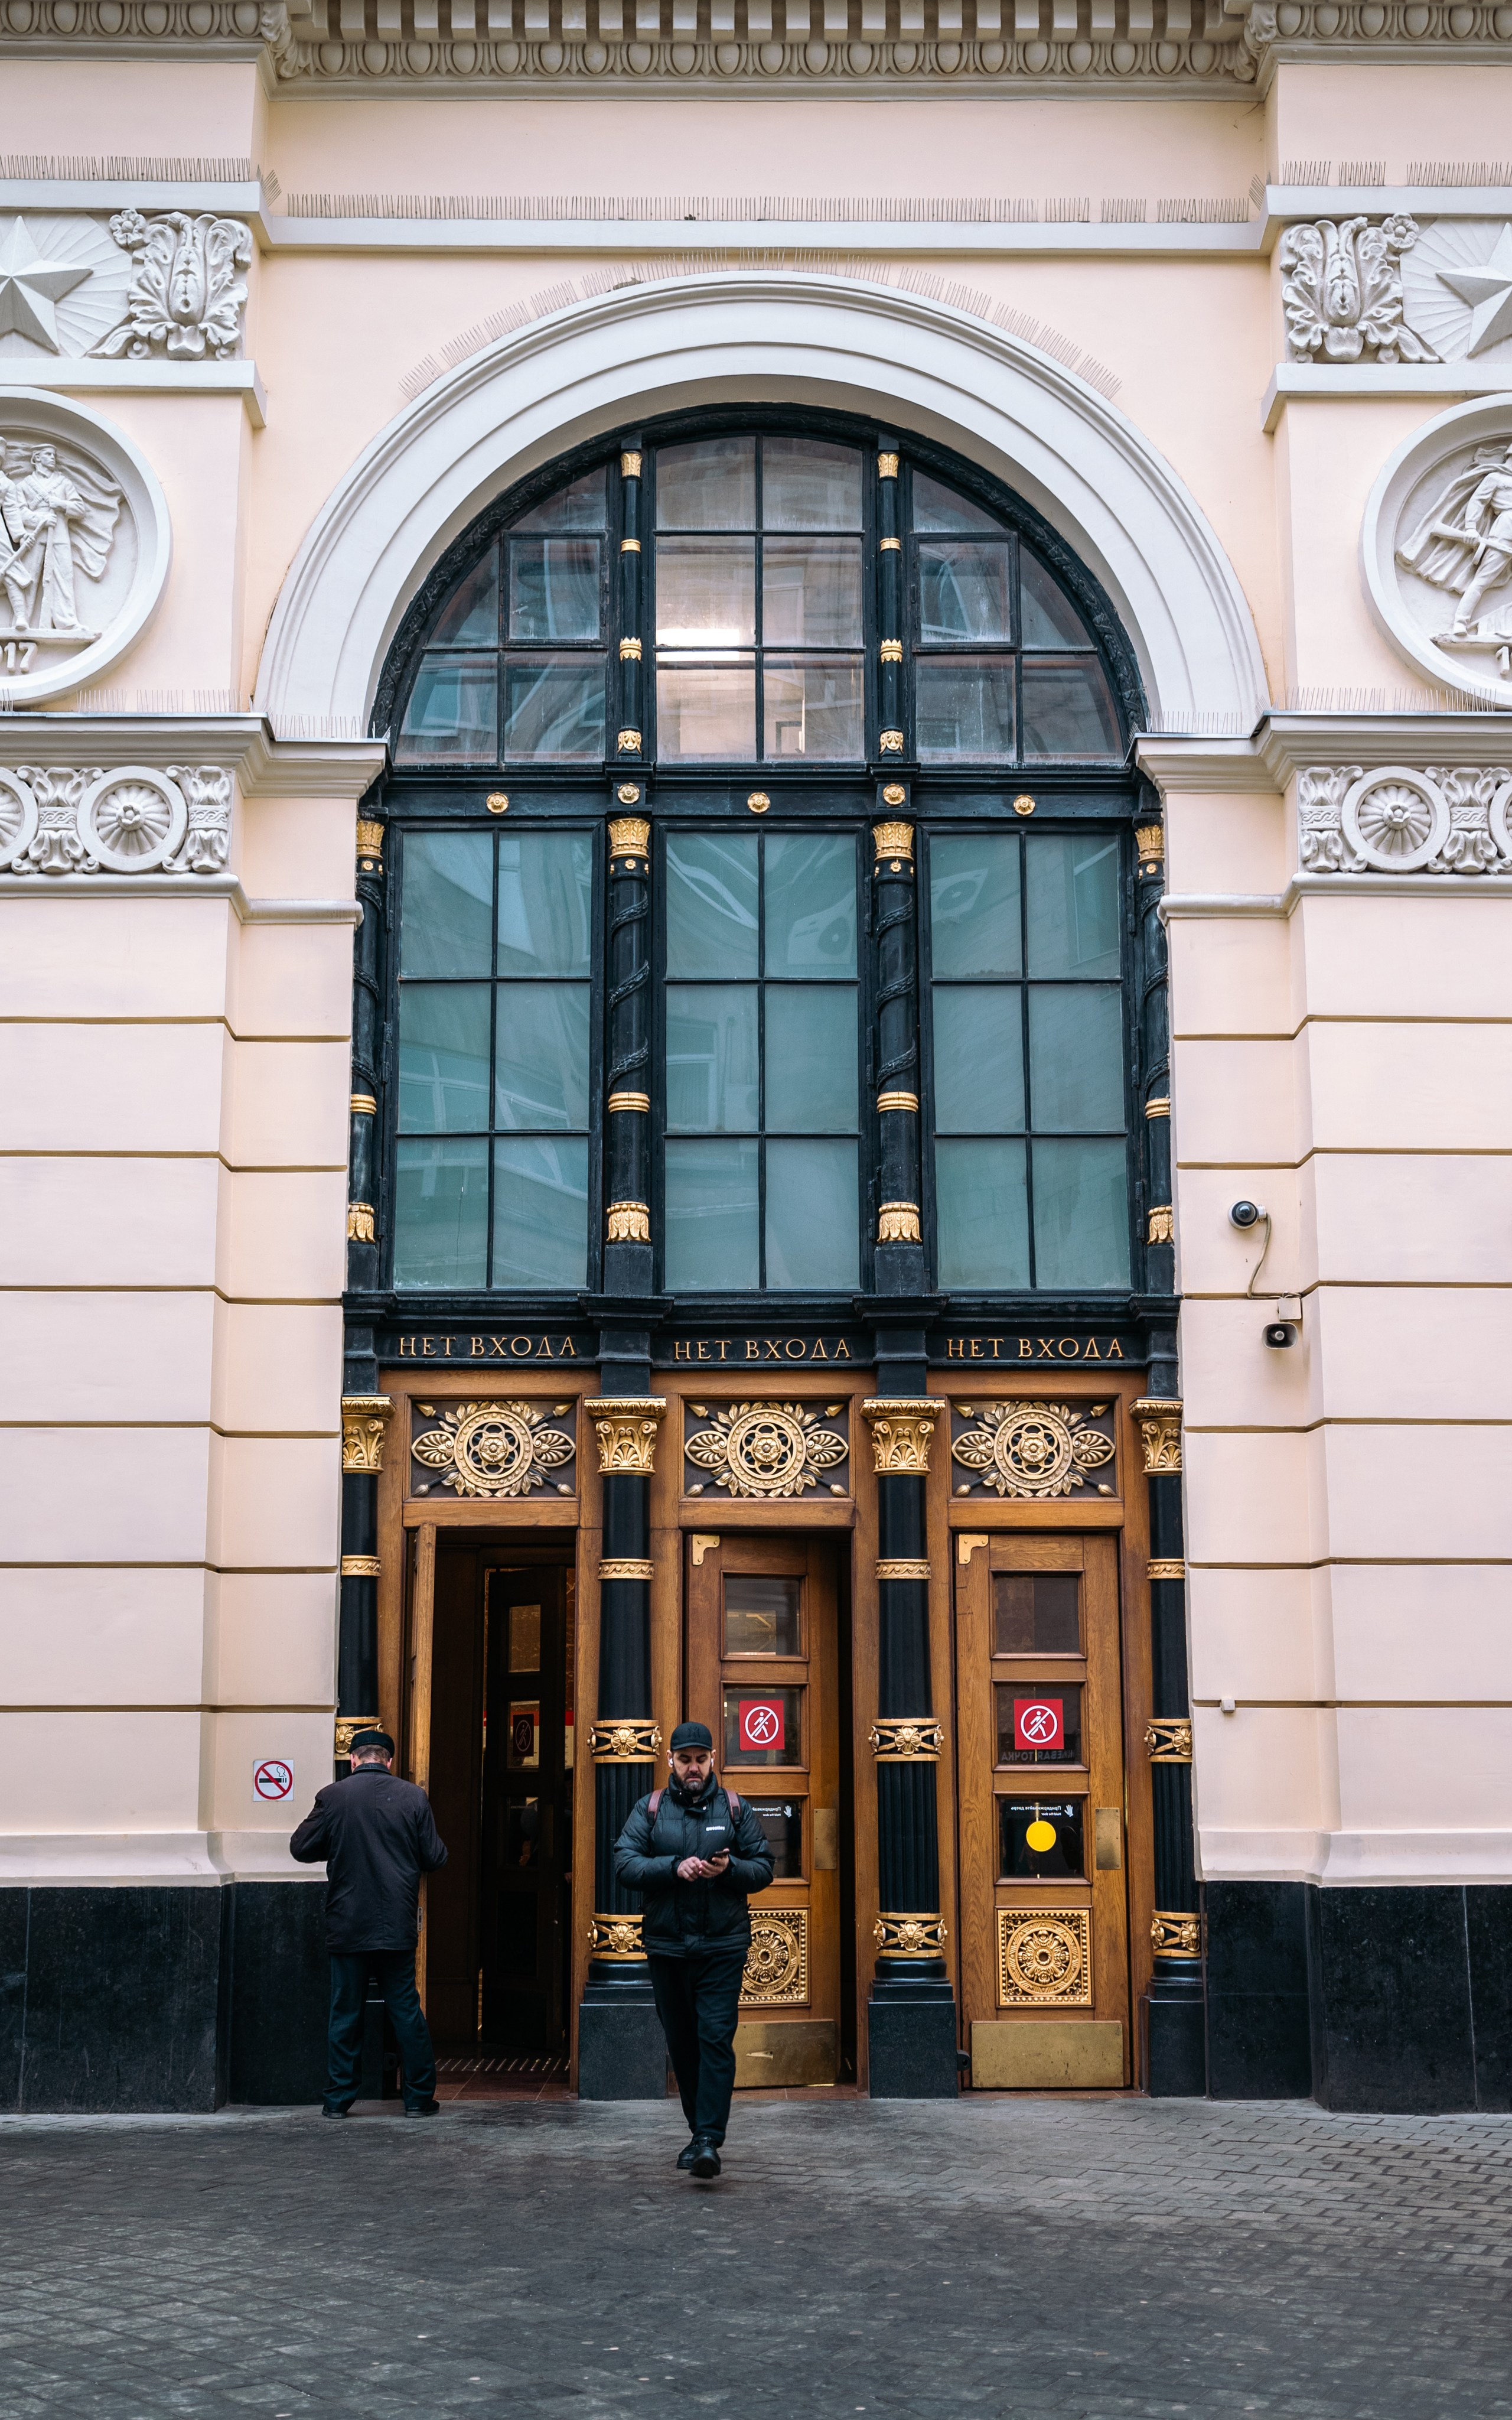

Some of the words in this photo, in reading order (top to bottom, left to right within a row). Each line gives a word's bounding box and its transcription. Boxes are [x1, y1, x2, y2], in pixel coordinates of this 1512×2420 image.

[0, 642, 38, 672] 17
[398, 1336, 456, 1356] НЕТ
[470, 1336, 577, 1358] ВХОДА
[674, 1340, 732, 1360] НЕТ
[745, 1338, 852, 1360] ВХОДА
[947, 1338, 1004, 1358] НЕТ
[1018, 1337, 1125, 1359] ВХОДА
